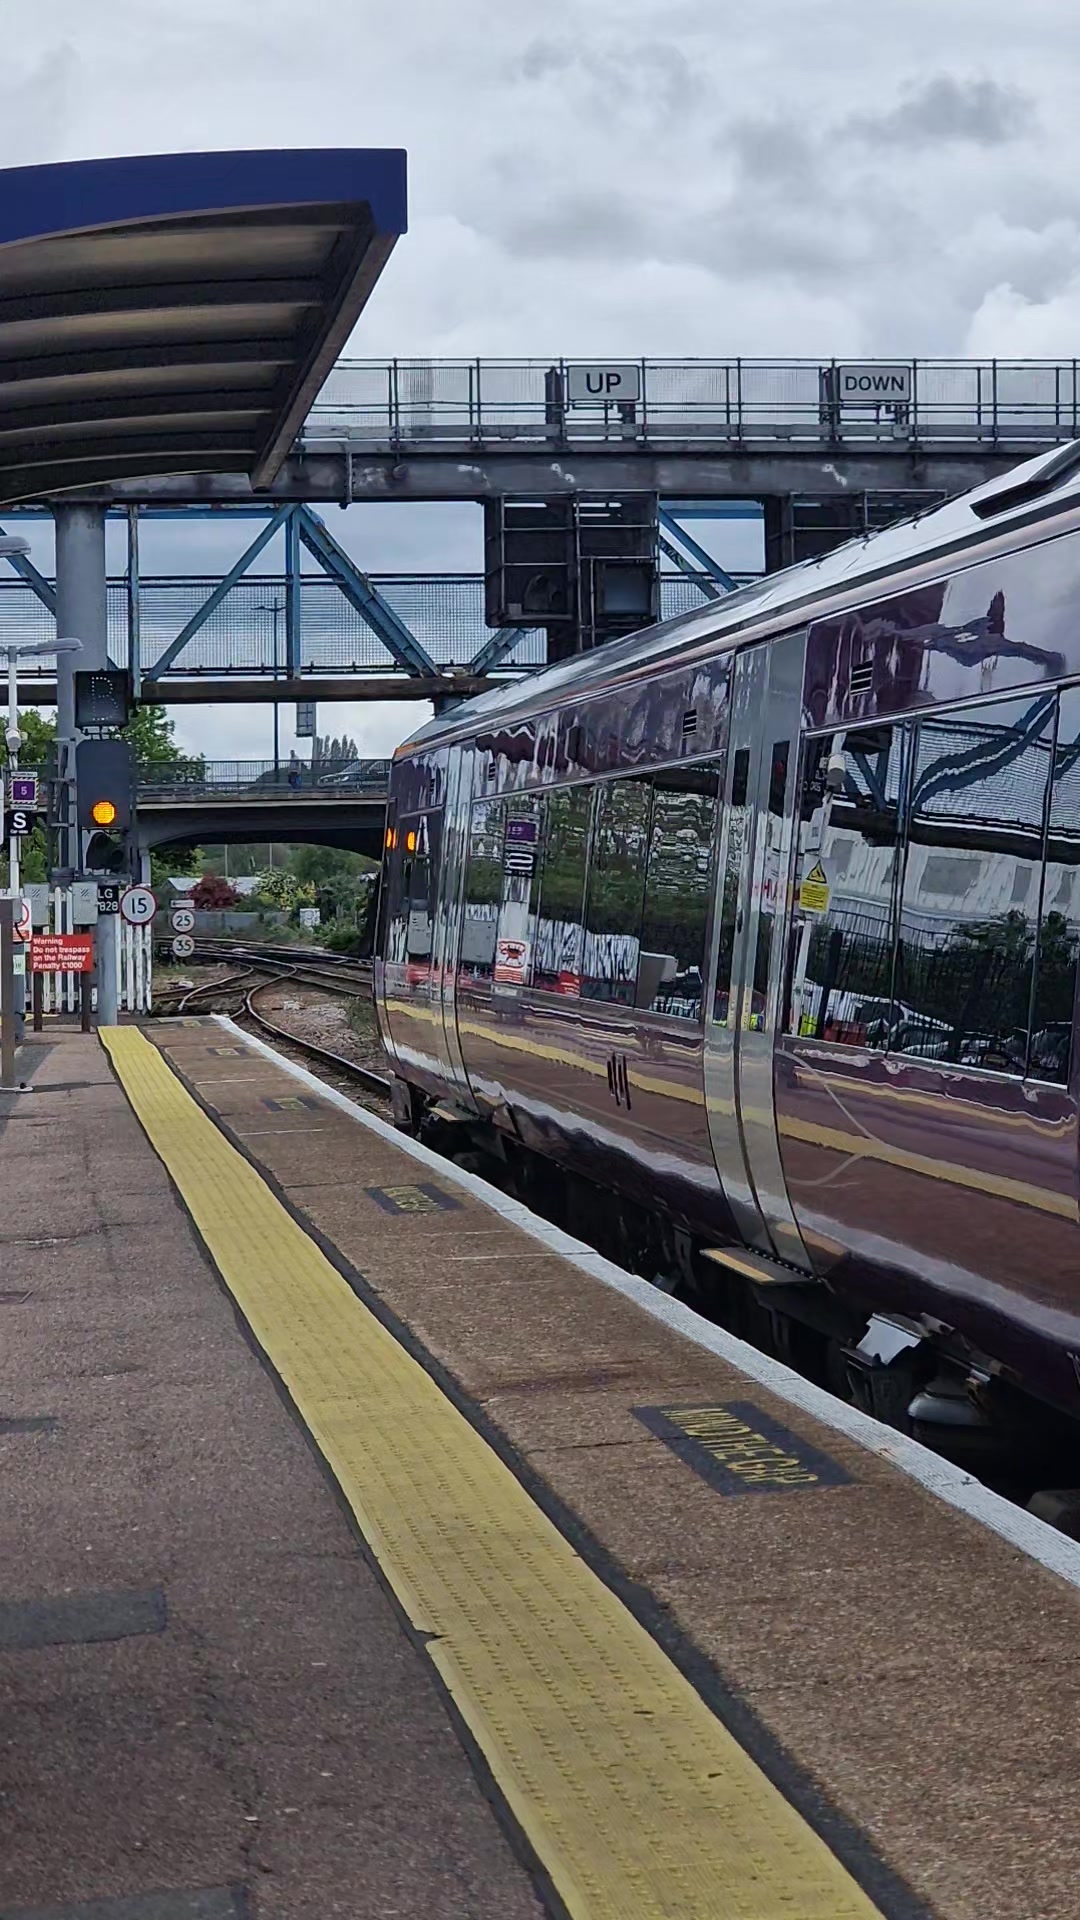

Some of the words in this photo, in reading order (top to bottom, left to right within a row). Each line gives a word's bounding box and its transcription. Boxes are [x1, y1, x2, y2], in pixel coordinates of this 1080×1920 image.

[586, 372, 622, 394] UP
[845, 375, 904, 391] DOWN
[20, 786, 28, 796] 5
[13, 812, 27, 829] S
[98, 888, 114, 899] LG
[100, 901, 119, 912] 828
[131, 897, 148, 914] 15
[176, 915, 192, 927] 25
[33, 937, 64, 946] Warning
[176, 939, 192, 952] 35
[33, 946, 44, 954] Do
[44, 946, 58, 954] not
[58, 946, 91, 956] trespass
[33, 954, 43, 962] on
[43, 954, 57, 962] the
[57, 954, 87, 963] Railway
[33, 962, 60, 971] Penalty
[61, 962, 83, 970] £1000
[699, 1433, 786, 1461] THE
[725, 1457, 819, 1484] GAP
